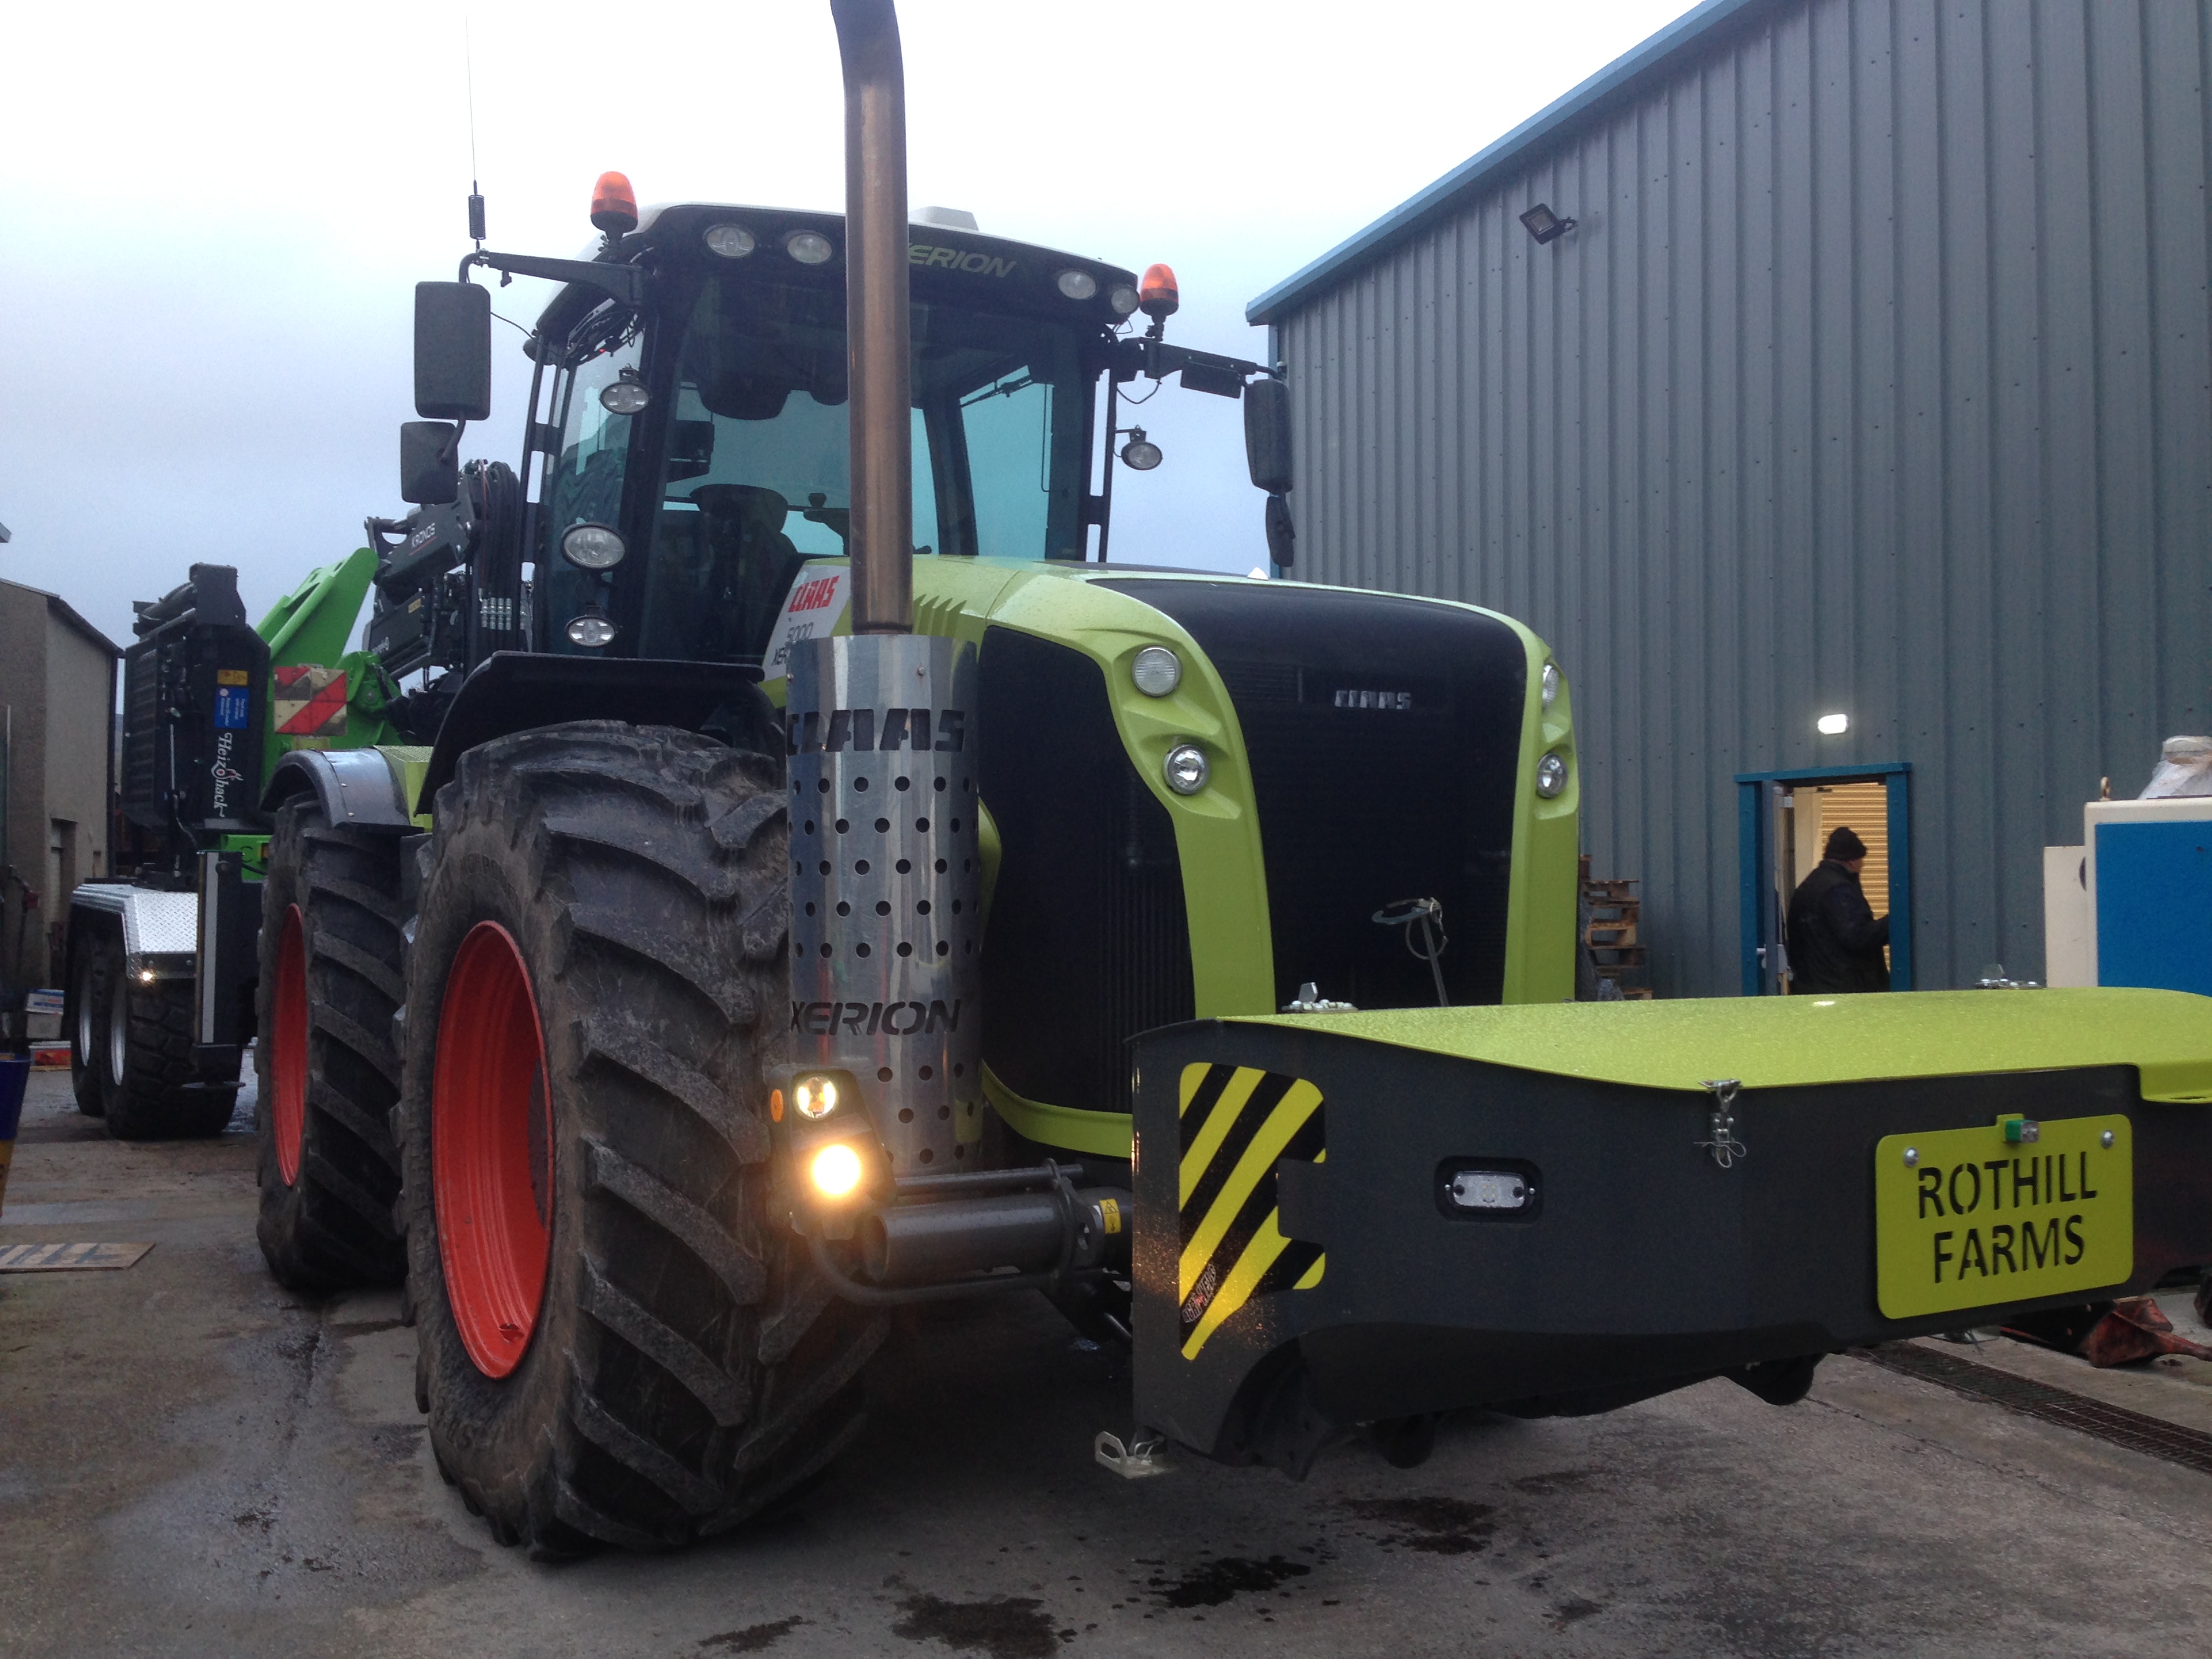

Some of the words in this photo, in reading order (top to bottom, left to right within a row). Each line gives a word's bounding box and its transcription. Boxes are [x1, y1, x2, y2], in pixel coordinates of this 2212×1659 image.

[909, 243, 1016, 278] ERION
[788, 575, 840, 613] CLAAS
[787, 621, 815, 641] 5000
[1334, 691, 1412, 710] CLAAS
[787, 708, 965, 756] CLAAS
[790, 999, 961, 1036] XERION
[1919, 1151, 2097, 1218] ROTHILL
[1934, 1214, 2085, 1284] FARMS
